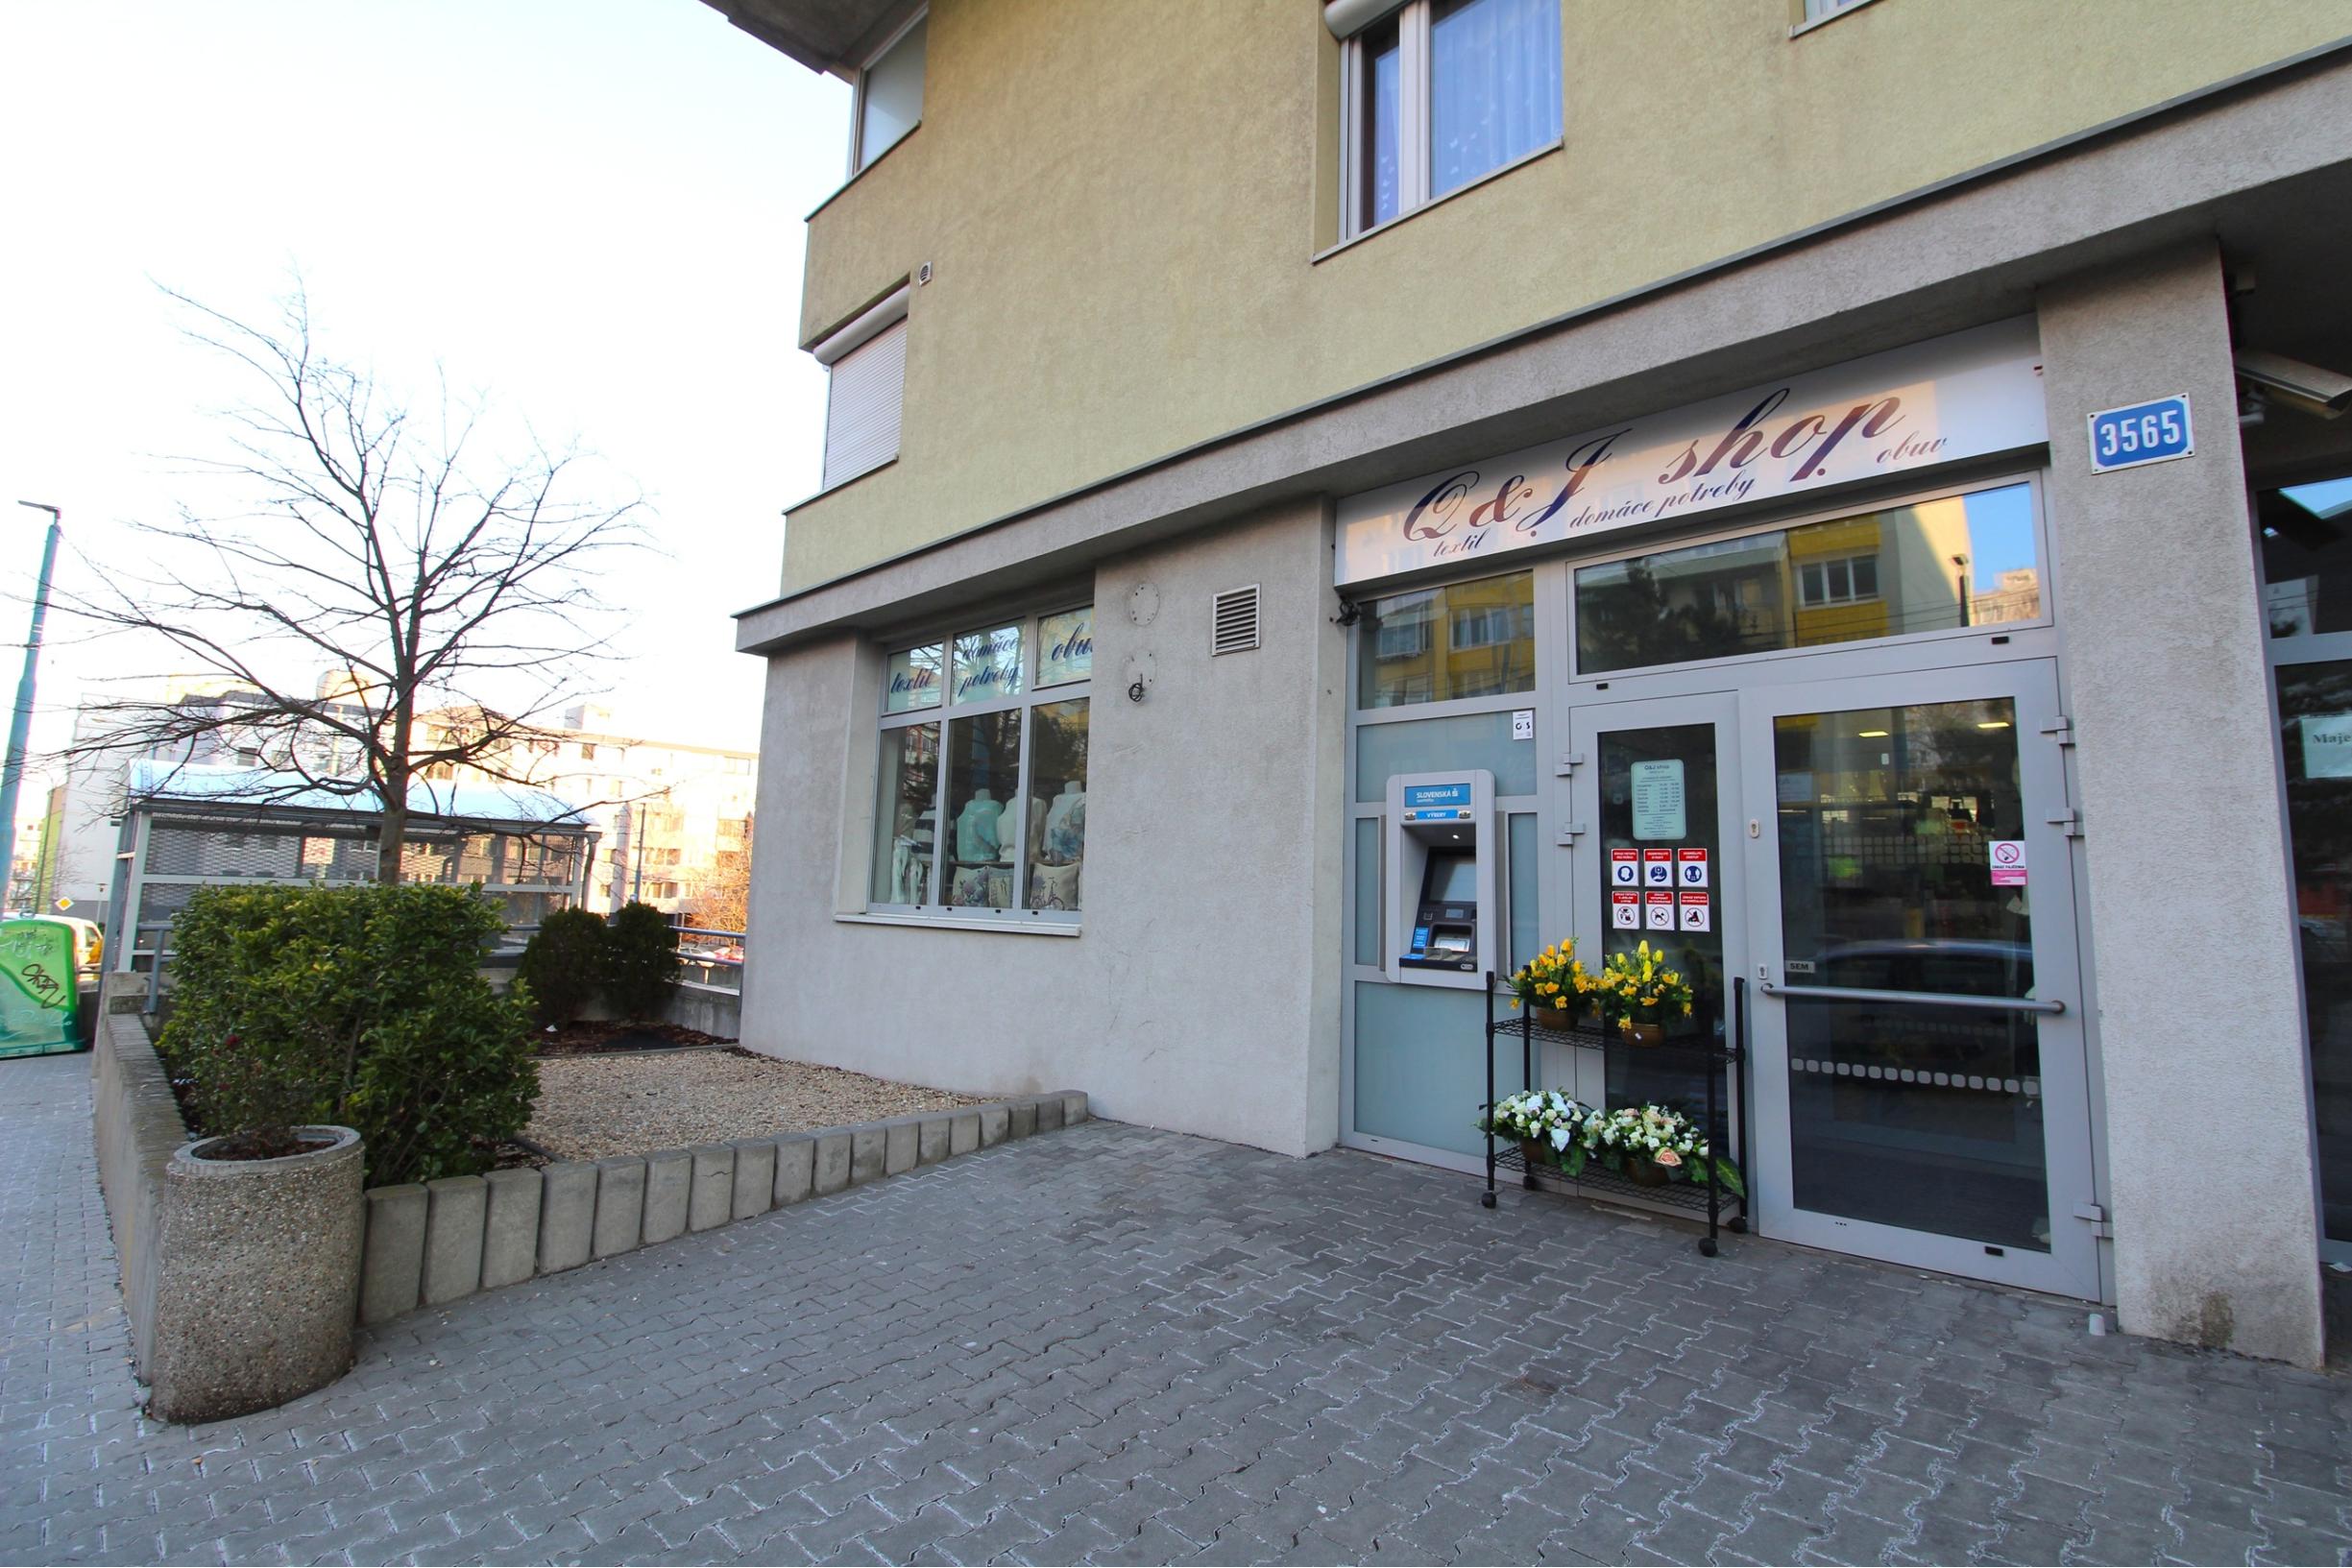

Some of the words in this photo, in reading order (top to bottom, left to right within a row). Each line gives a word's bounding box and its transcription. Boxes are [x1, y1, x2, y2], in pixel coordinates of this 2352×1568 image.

[1658, 387, 1906, 483] shop
[1877, 430, 1948, 464] obuv
[2100, 409, 2181, 457] 3565
[1569, 499, 1654, 529] domáce
[1656, 470, 1755, 517] potreby
[1433, 529, 1491, 557] textil
[1052, 622, 1093, 661] obu
[890, 667, 933, 693] textil
[958, 664, 1020, 696] potreby
[1789, 962, 1809, 971] SEM
